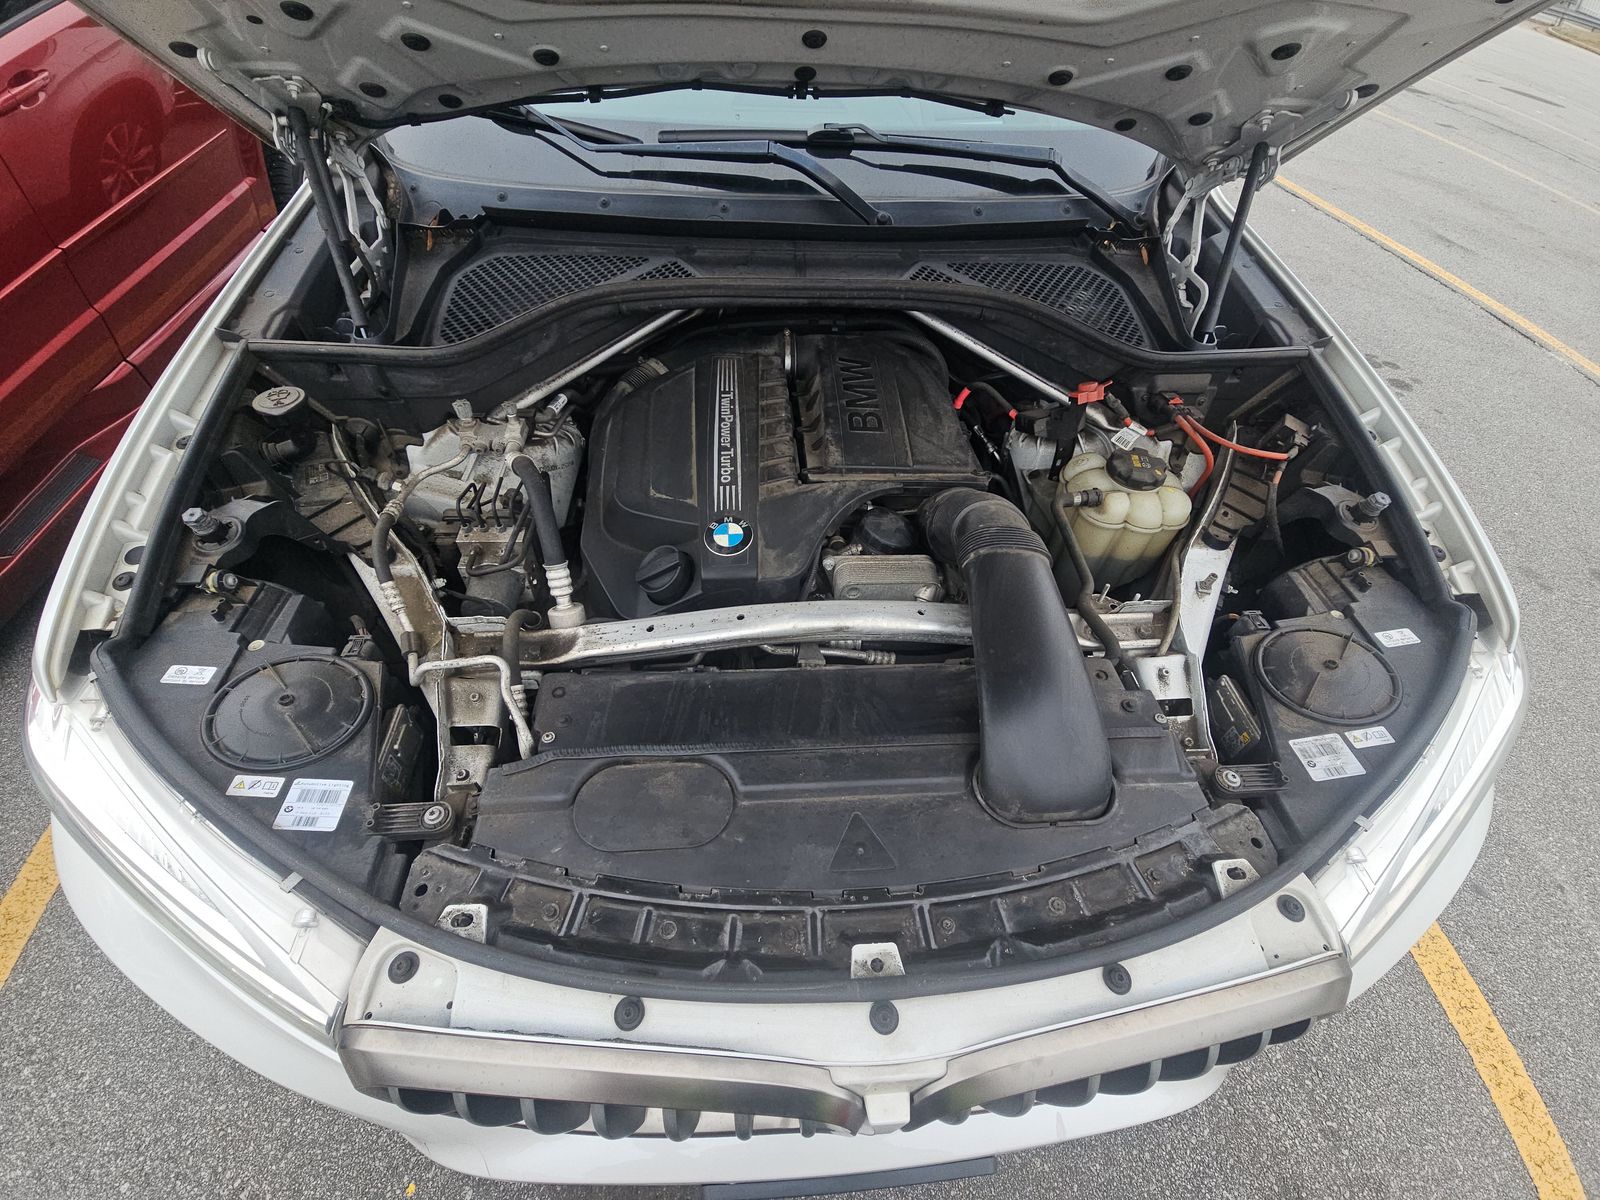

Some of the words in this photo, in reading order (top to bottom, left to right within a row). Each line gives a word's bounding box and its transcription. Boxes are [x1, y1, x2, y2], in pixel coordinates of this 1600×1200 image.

[838, 357, 885, 433] BMW
[720, 392, 734, 448] TwinPower
[720, 448, 735, 483] Turbo
[709, 516, 748, 530] BMW
